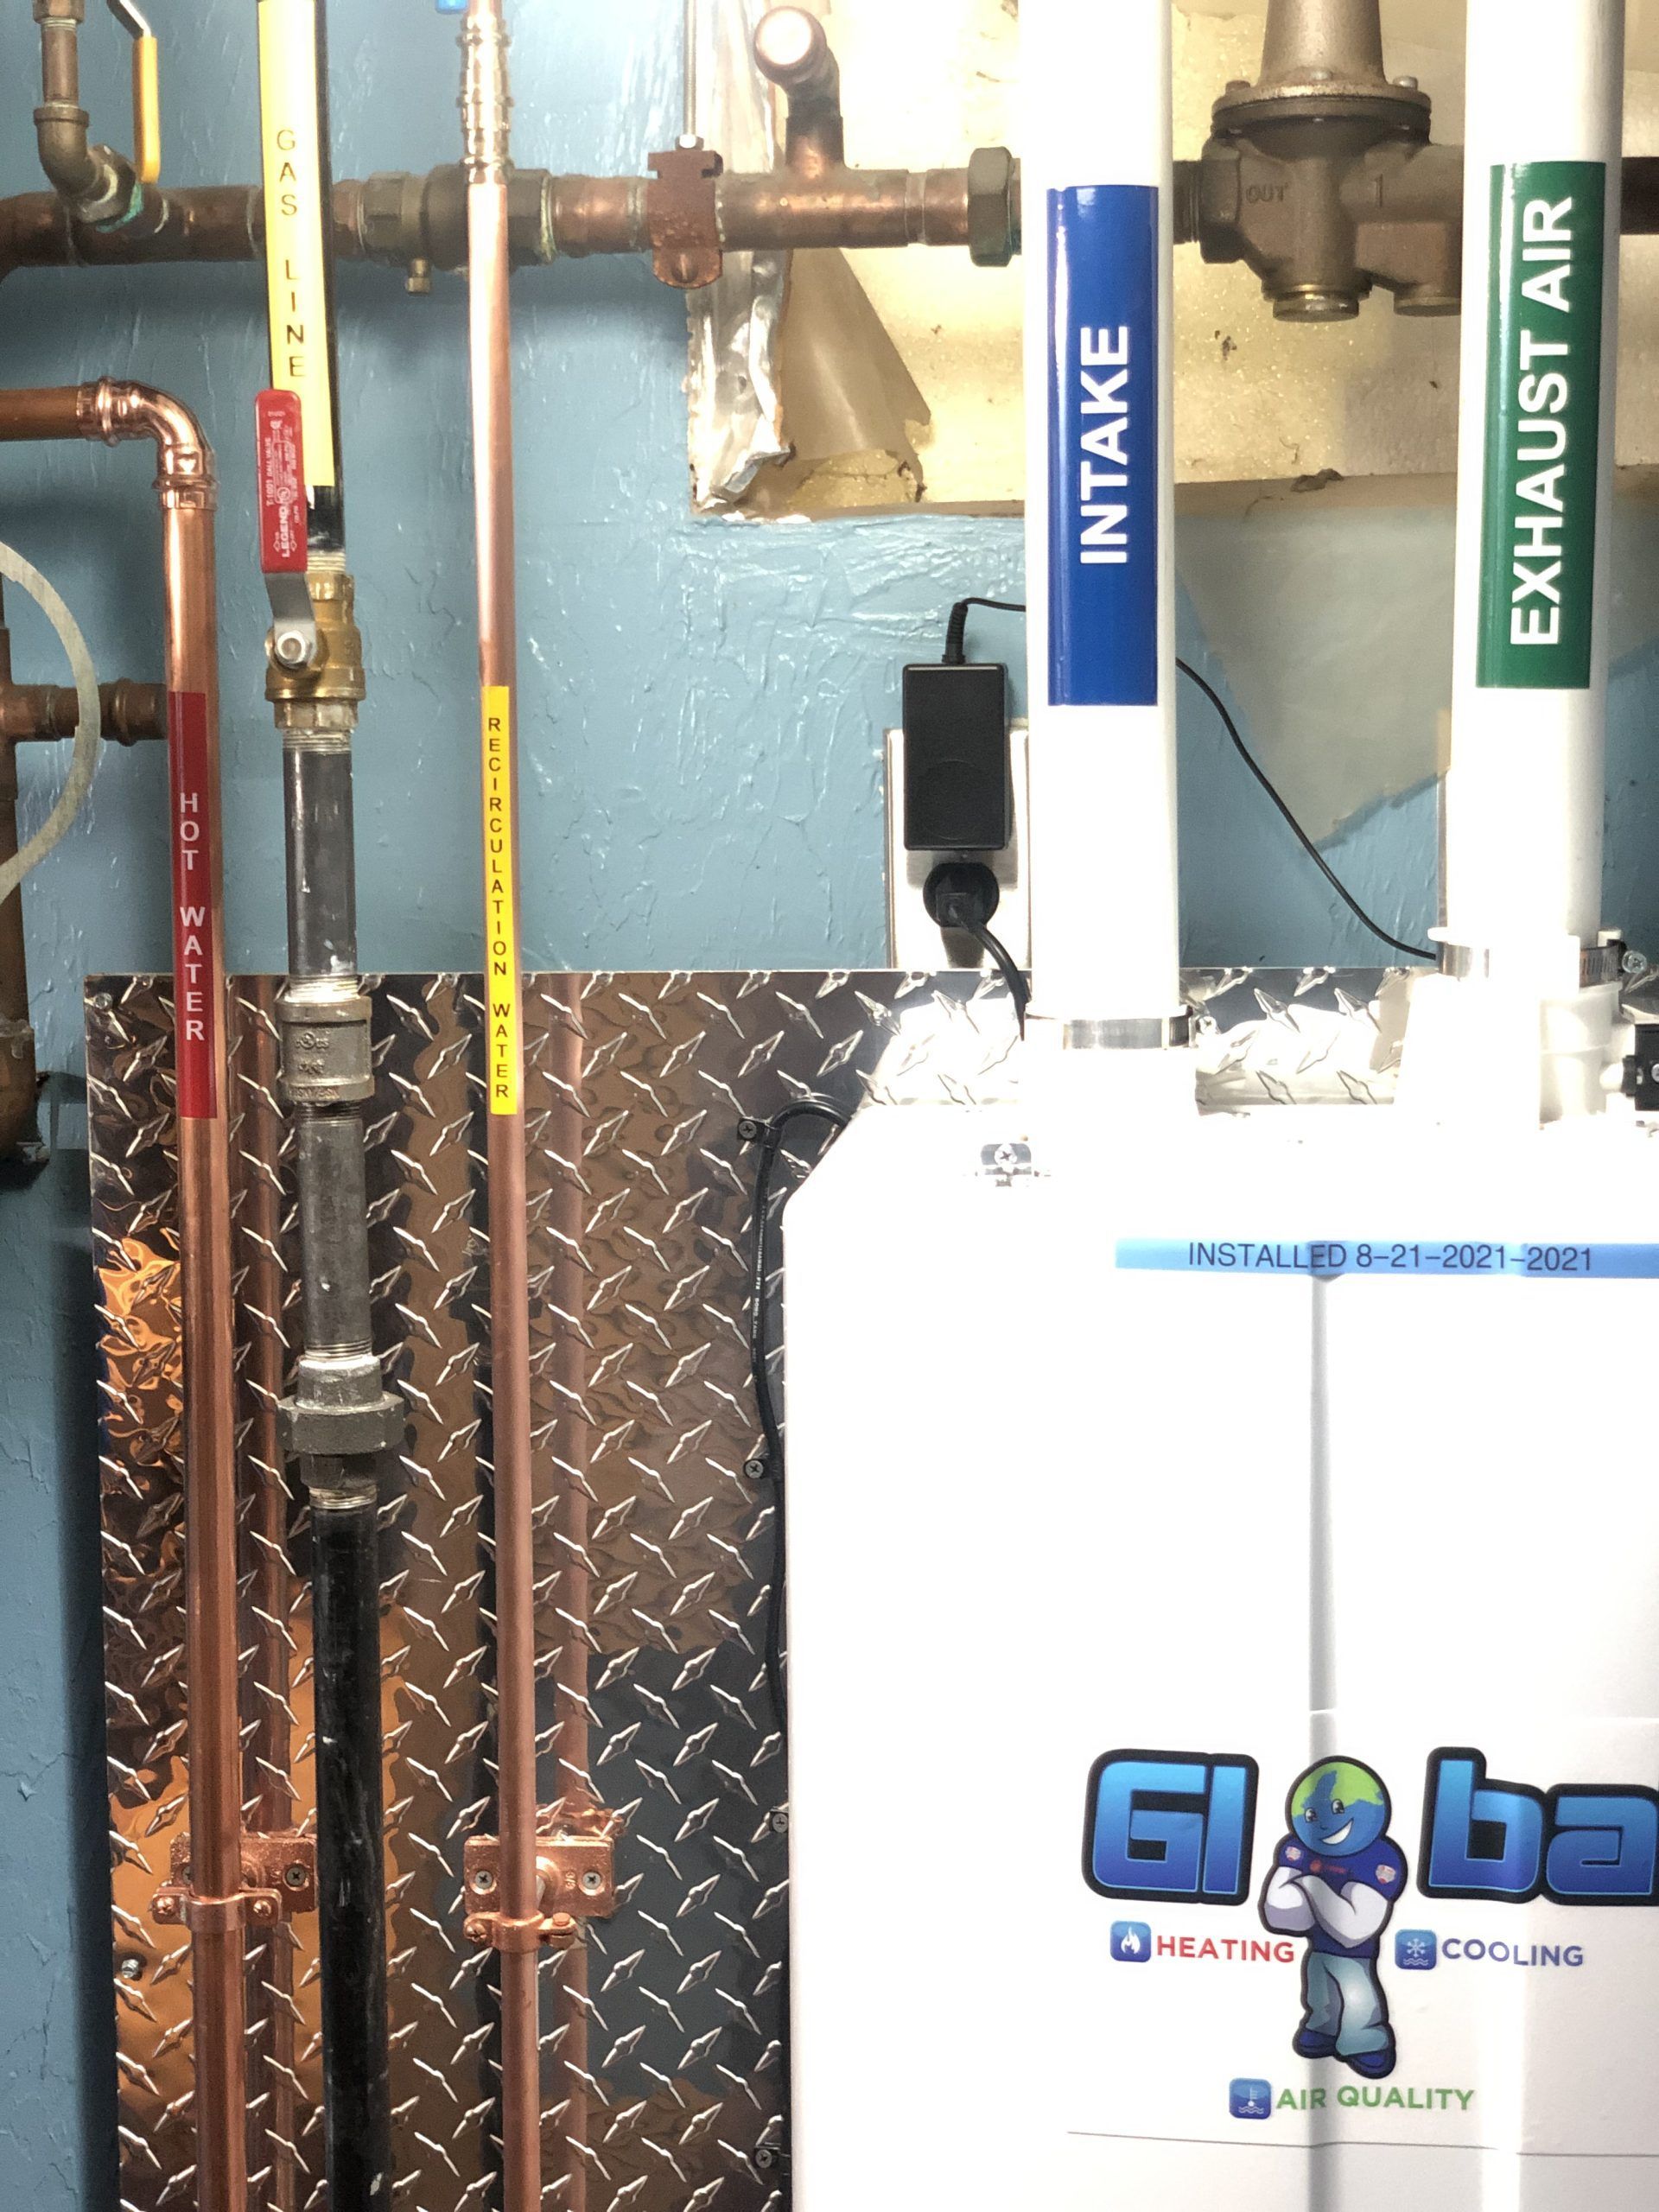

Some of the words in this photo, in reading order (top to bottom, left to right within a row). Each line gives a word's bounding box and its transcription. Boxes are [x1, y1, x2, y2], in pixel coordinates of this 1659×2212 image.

[276, 129, 297, 217] GAS
[1522, 196, 1573, 314] AIR
[285, 259, 307, 378] LINE
[1080, 325, 1128, 564] INTAKE
[1510, 328, 1569, 645] EXHAUST
[278, 506, 290, 558] LEGEND
[180, 792, 200, 870] HOT
[488, 717, 507, 976] RECIRCULATION
[180, 906, 206, 1041] WATER
[493, 1003, 511, 1097] WATER
[1189, 1242, 1346, 1268] INSTALLED
[1356, 1243, 1592, 1271] 8-21-2021-2021
[1156, 1935, 1295, 1963] HEATING
[1442, 1937, 1584, 1967] COOLING
[1276, 2088, 1326, 2110] AIR
[1337, 2085, 1474, 2111] QUALITY
